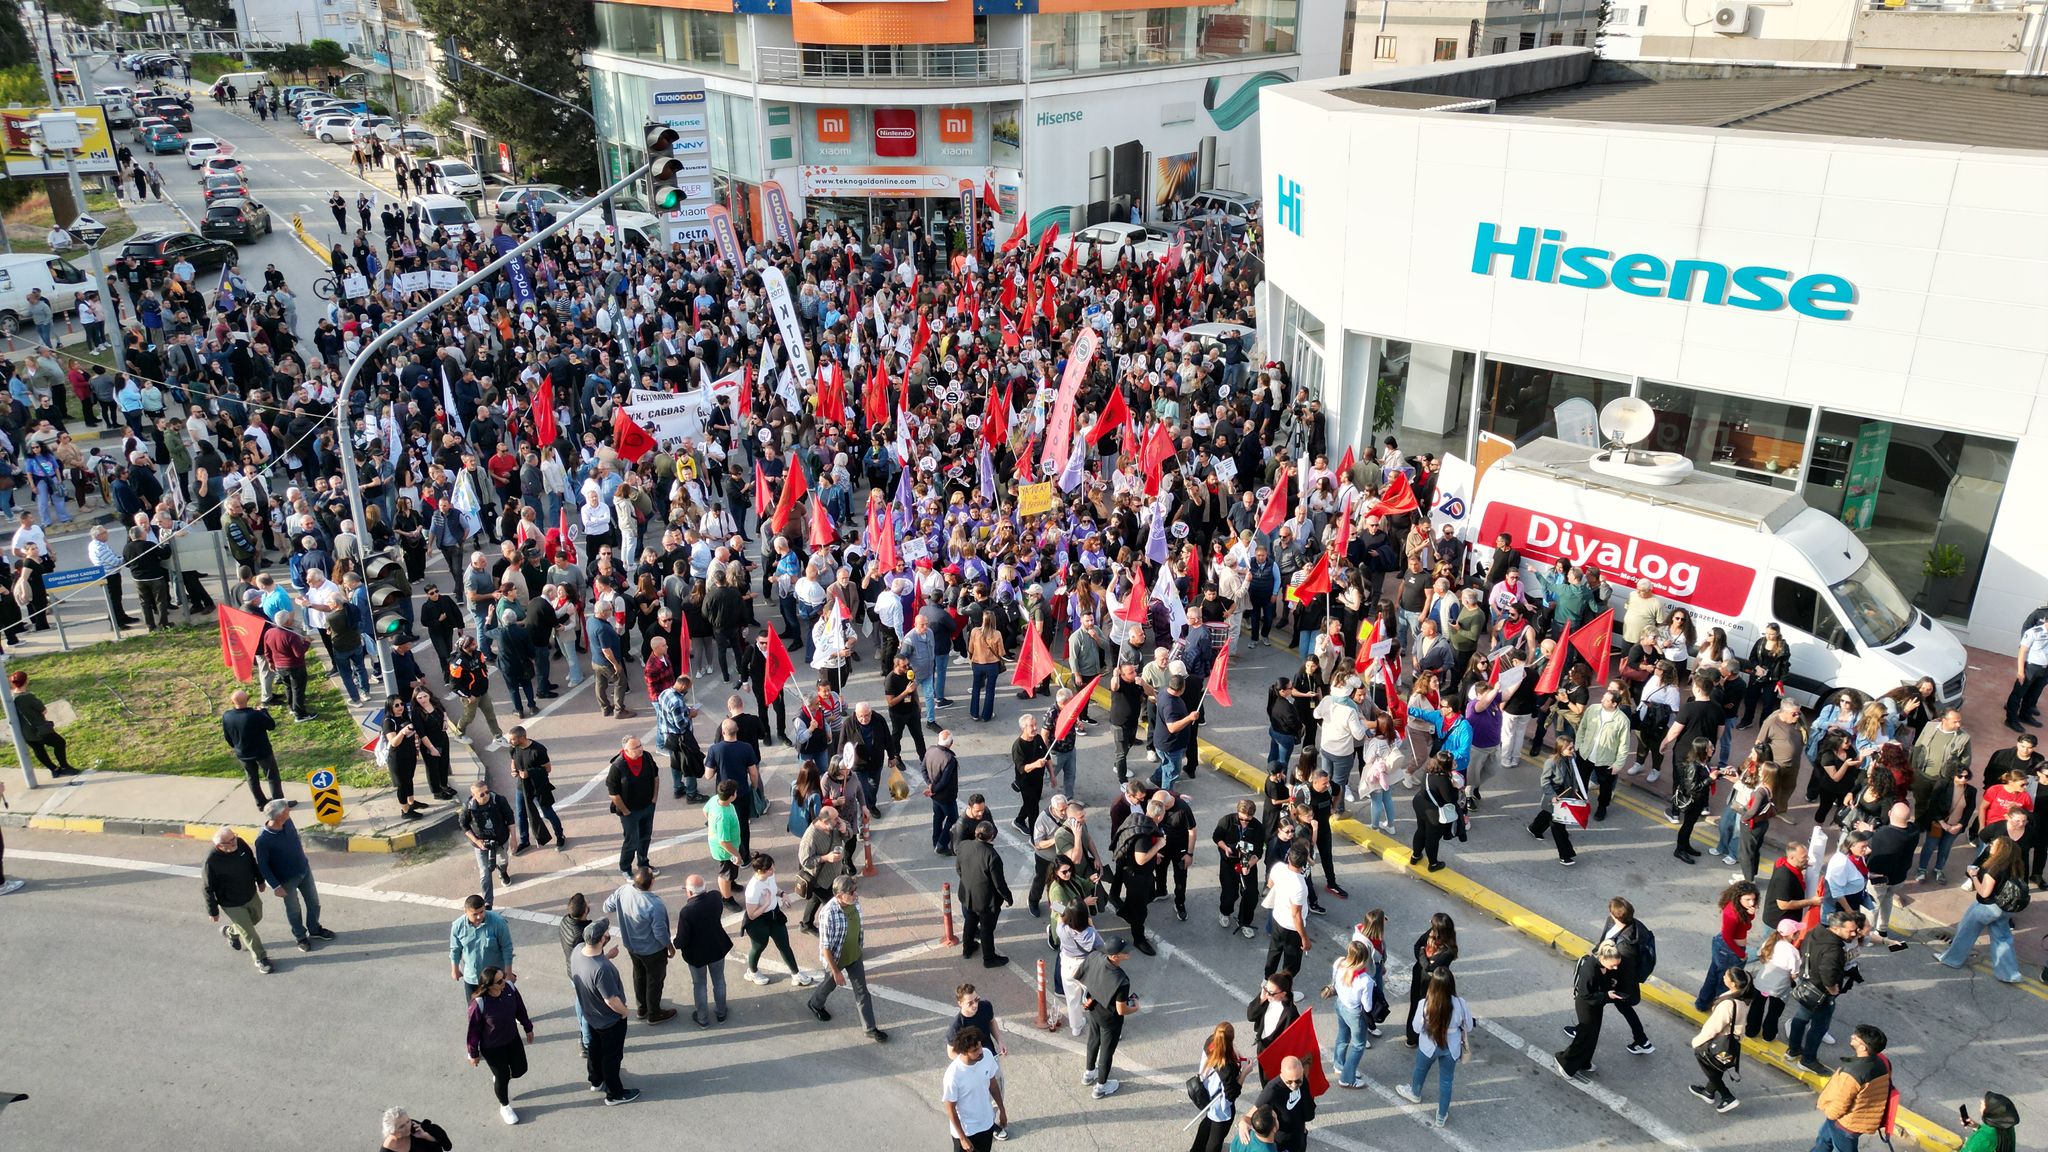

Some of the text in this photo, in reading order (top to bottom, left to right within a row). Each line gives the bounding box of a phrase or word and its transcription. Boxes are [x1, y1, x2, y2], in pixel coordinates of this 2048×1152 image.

[656, 92, 704, 102] TEKNOGOLD
[1036, 109, 1084, 127] Hisense
[879, 129, 912, 137] Nintendo
[672, 141, 704, 150] UNNY
[819, 146, 852, 156] xiaomi
[941, 147, 973, 156] xiaomi
[814, 177, 917, 187] www.teknogoldonline.com
[681, 184, 702, 192] DLER
[1278, 174, 1305, 237] Hi
[678, 228, 708, 240] DELTA
[1471, 221, 1856, 320] Hisense
[1526, 514, 1700, 597] Diyalog
[1620, 572, 1640, 584] Medy
